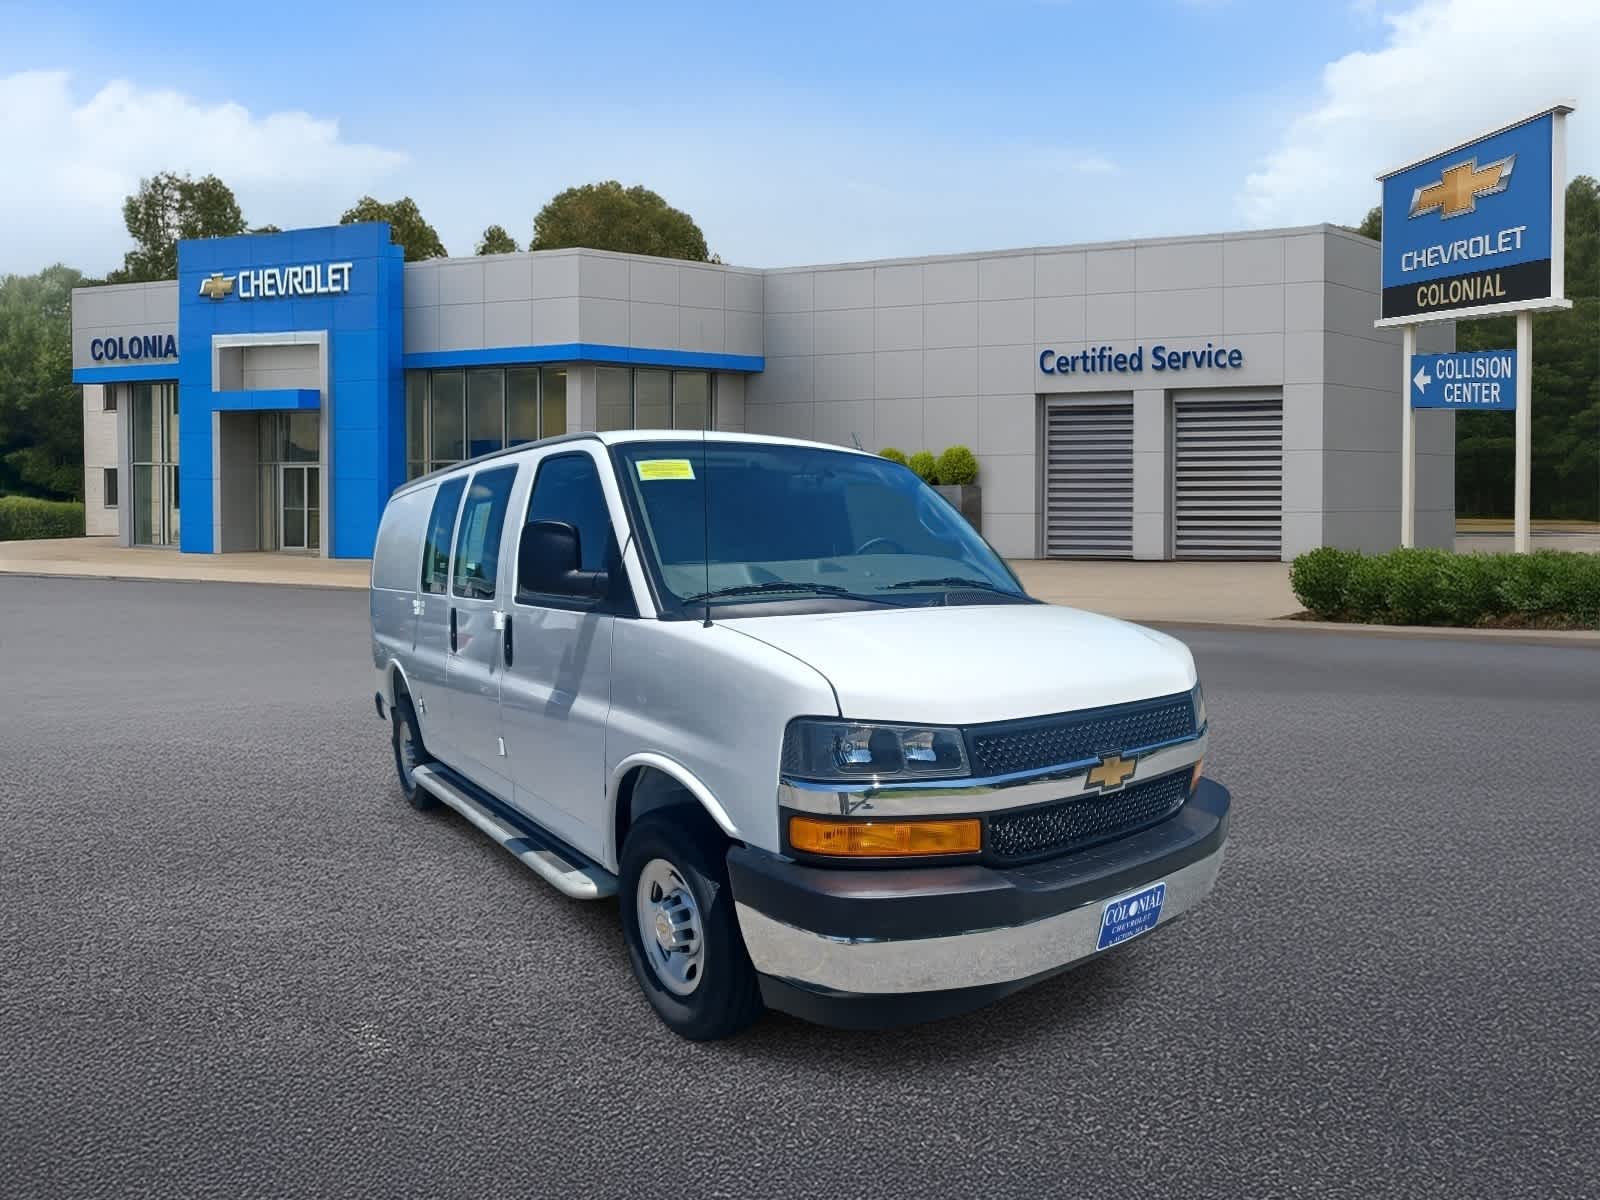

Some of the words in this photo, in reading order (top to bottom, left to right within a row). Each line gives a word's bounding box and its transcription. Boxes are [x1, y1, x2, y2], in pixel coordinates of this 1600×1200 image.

[1401, 225, 1527, 272] CHEVROLET
[238, 261, 353, 299] CHEVROLET
[1416, 273, 1506, 307] COLONIAL
[91, 334, 178, 361] COLONIA
[1039, 346, 1143, 375] Certified
[1151, 343, 1243, 371] Service
[1436, 357, 1512, 381] COLLISION
[1444, 382, 1501, 403] CENTER
[1105, 890, 1162, 926] COLONIAL
